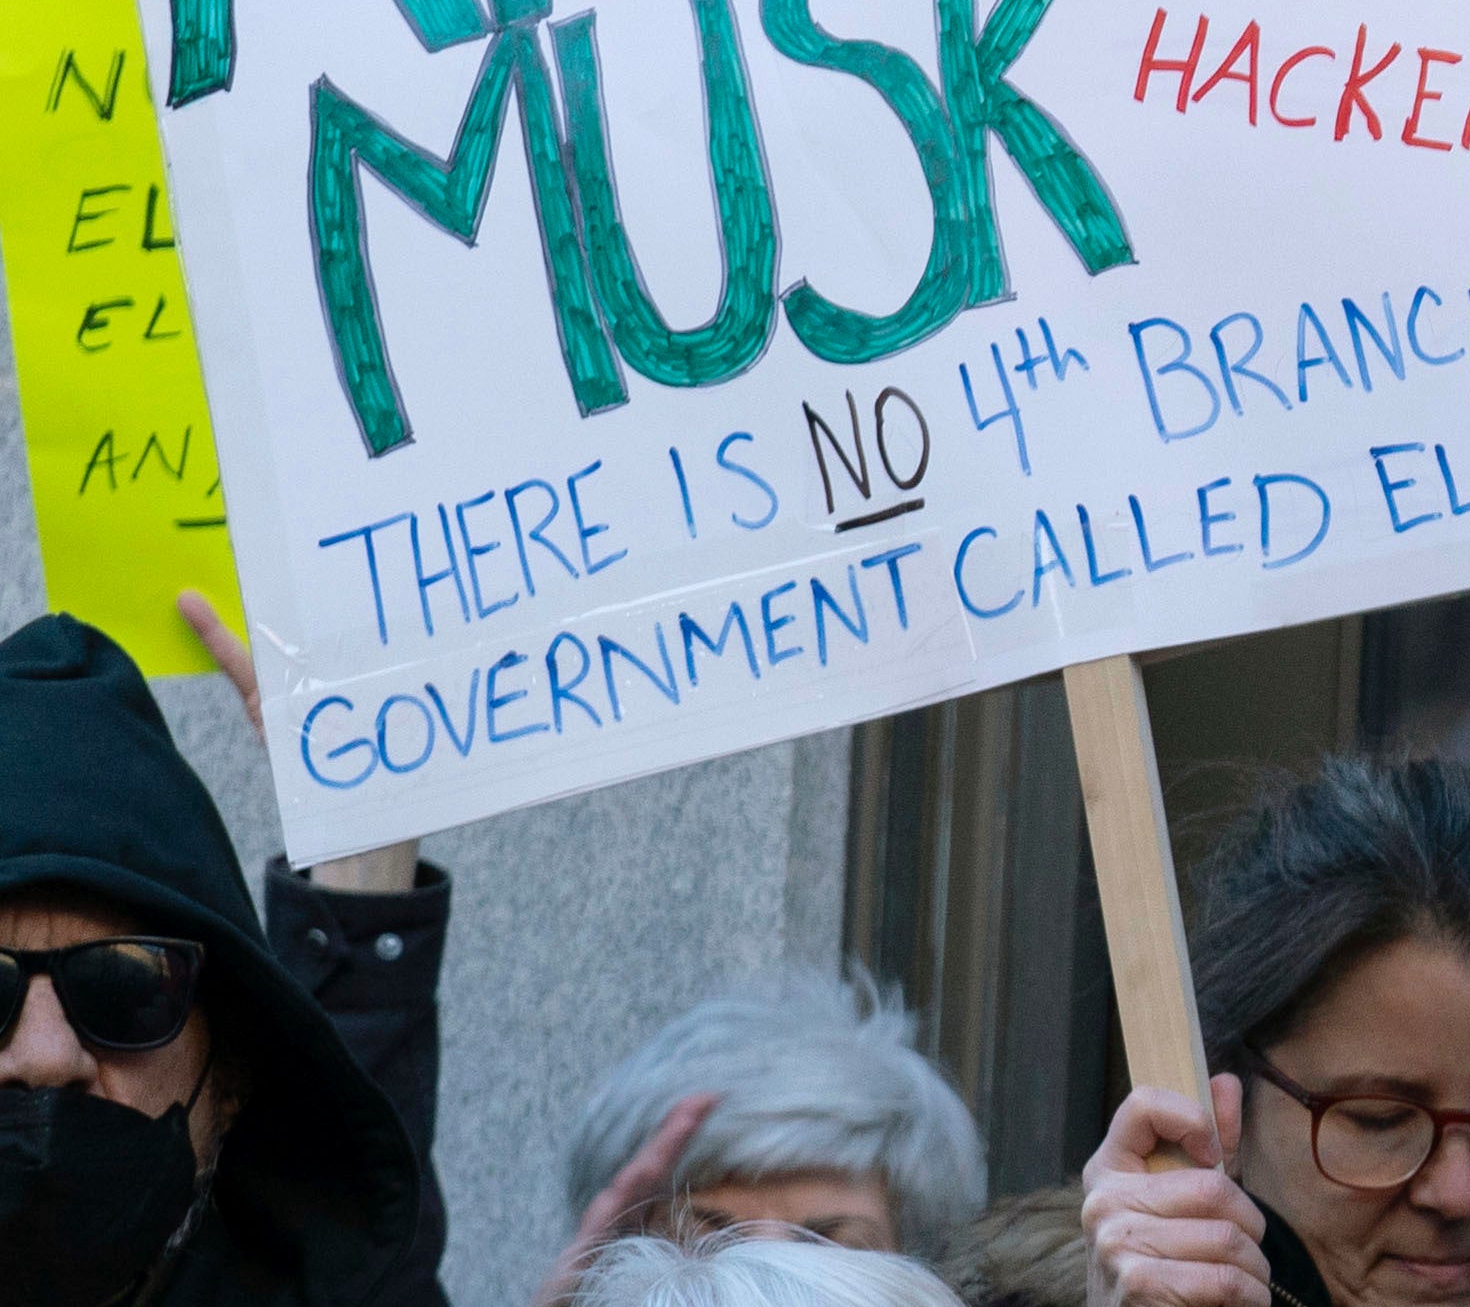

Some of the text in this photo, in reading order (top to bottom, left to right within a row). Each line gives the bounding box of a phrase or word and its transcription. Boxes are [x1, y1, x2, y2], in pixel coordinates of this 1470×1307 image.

[47, 48, 152, 121] N
[79, 425, 220, 497] AN
[318, 460, 628, 645] THERE
[669, 431, 778, 538] IS
[802, 385, 930, 514] NO
[959, 316, 1089, 476] 4th
[302, 543, 922, 789] GOVERNMENT
[954, 474, 1331, 618] CALLED
